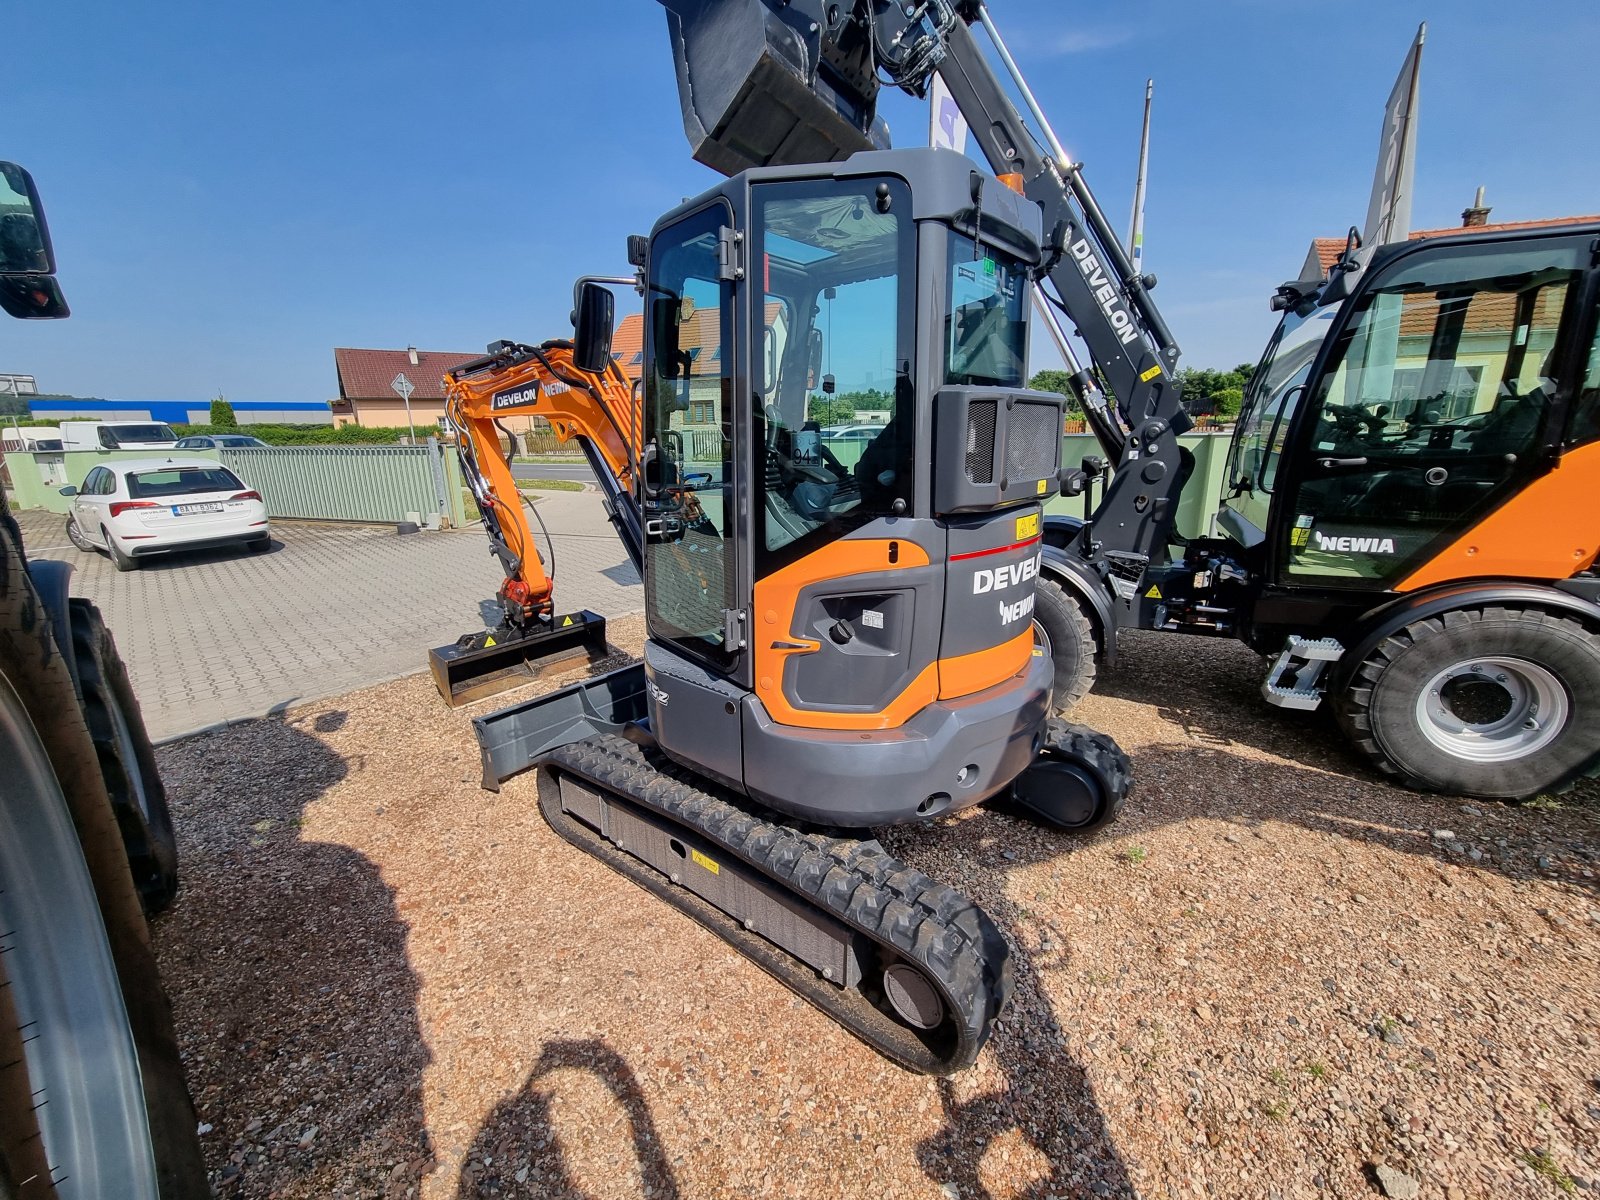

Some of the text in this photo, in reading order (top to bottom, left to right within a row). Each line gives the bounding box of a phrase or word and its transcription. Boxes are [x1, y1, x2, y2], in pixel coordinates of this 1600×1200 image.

[1071, 238, 1139, 345] DEVELON
[497, 388, 536, 407] DEVELON
[1320, 536, 1395, 554] NEWIA
[973, 550, 1042, 595] DEVELO
